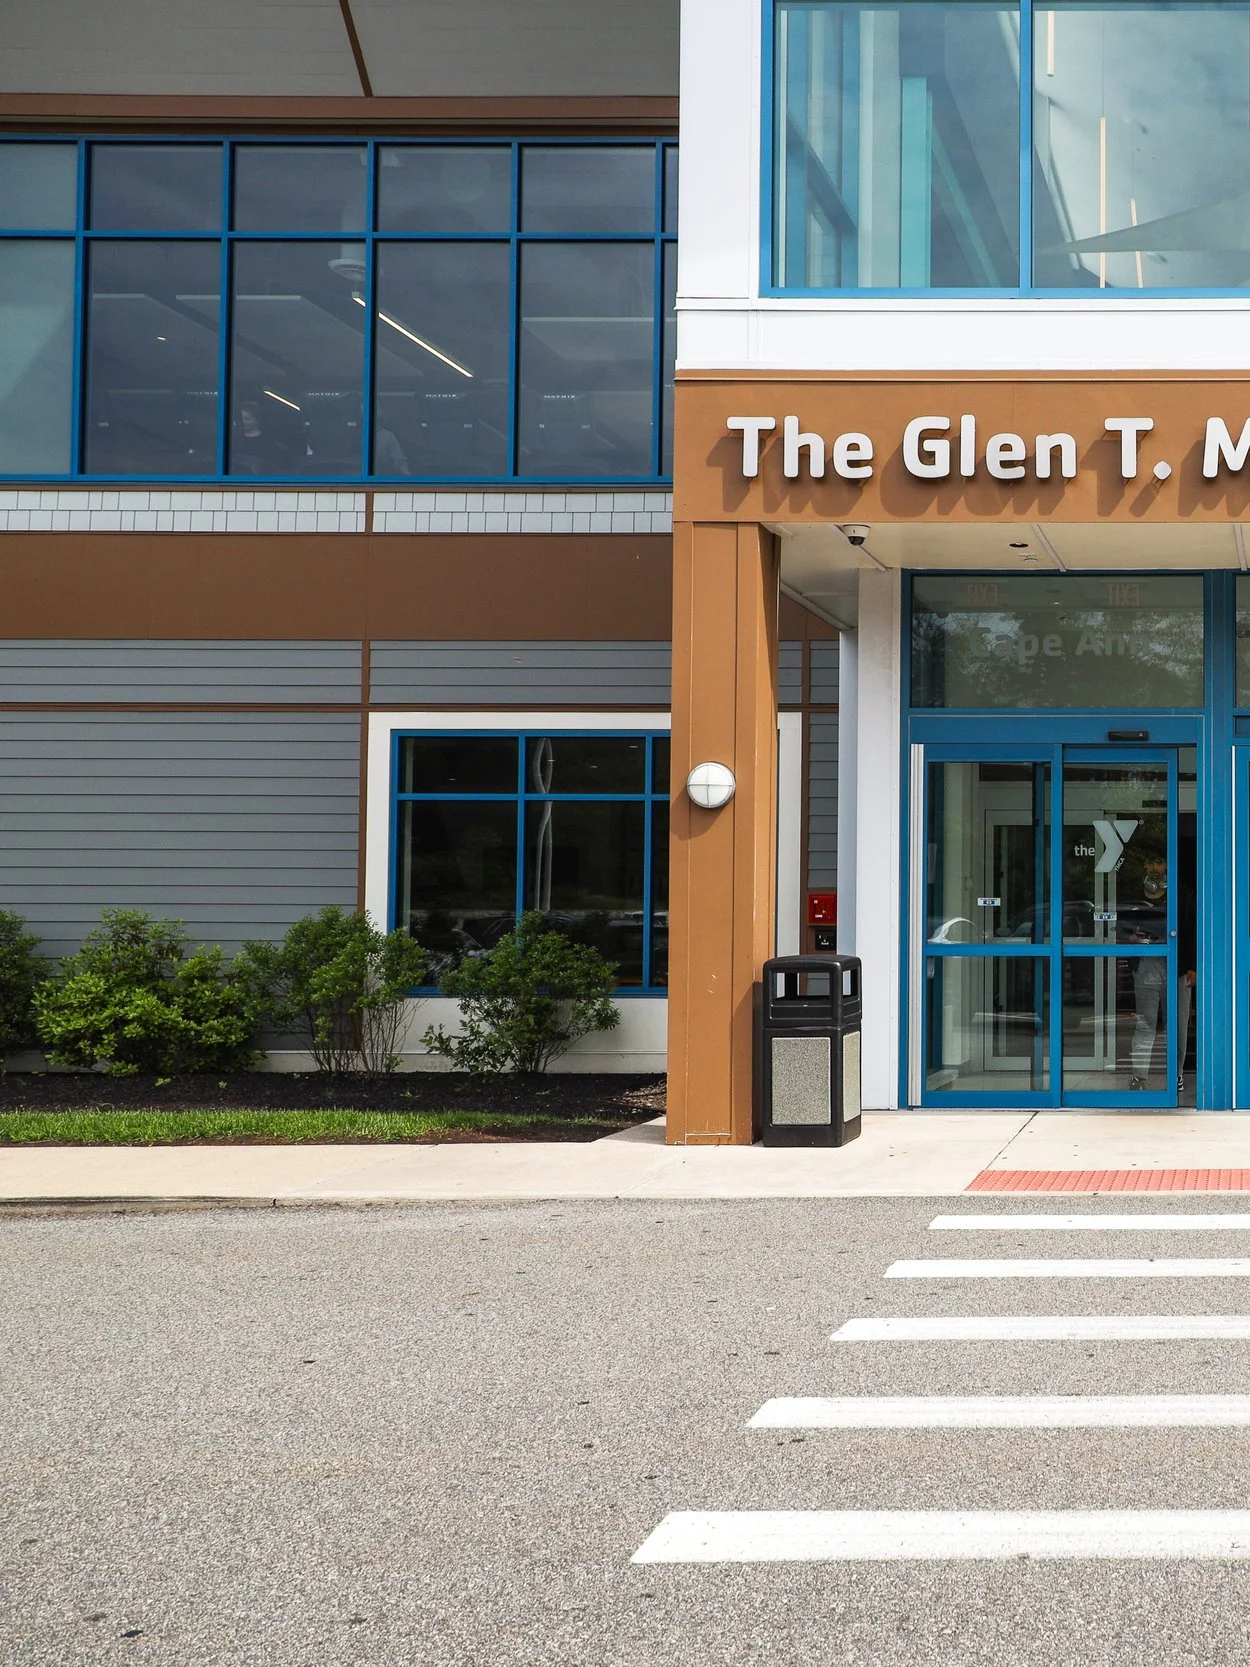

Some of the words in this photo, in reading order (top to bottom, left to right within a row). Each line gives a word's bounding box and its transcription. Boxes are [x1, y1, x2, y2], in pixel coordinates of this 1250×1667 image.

[726, 414, 875, 480] The
[902, 413, 1078, 480] Glen
[1104, 416, 1173, 481] T.
[969, 626, 1063, 665] Cape
[1075, 628, 1152, 657] Ann
[1074, 844, 1096, 857] the
[1114, 857, 1126, 872] YMCA
